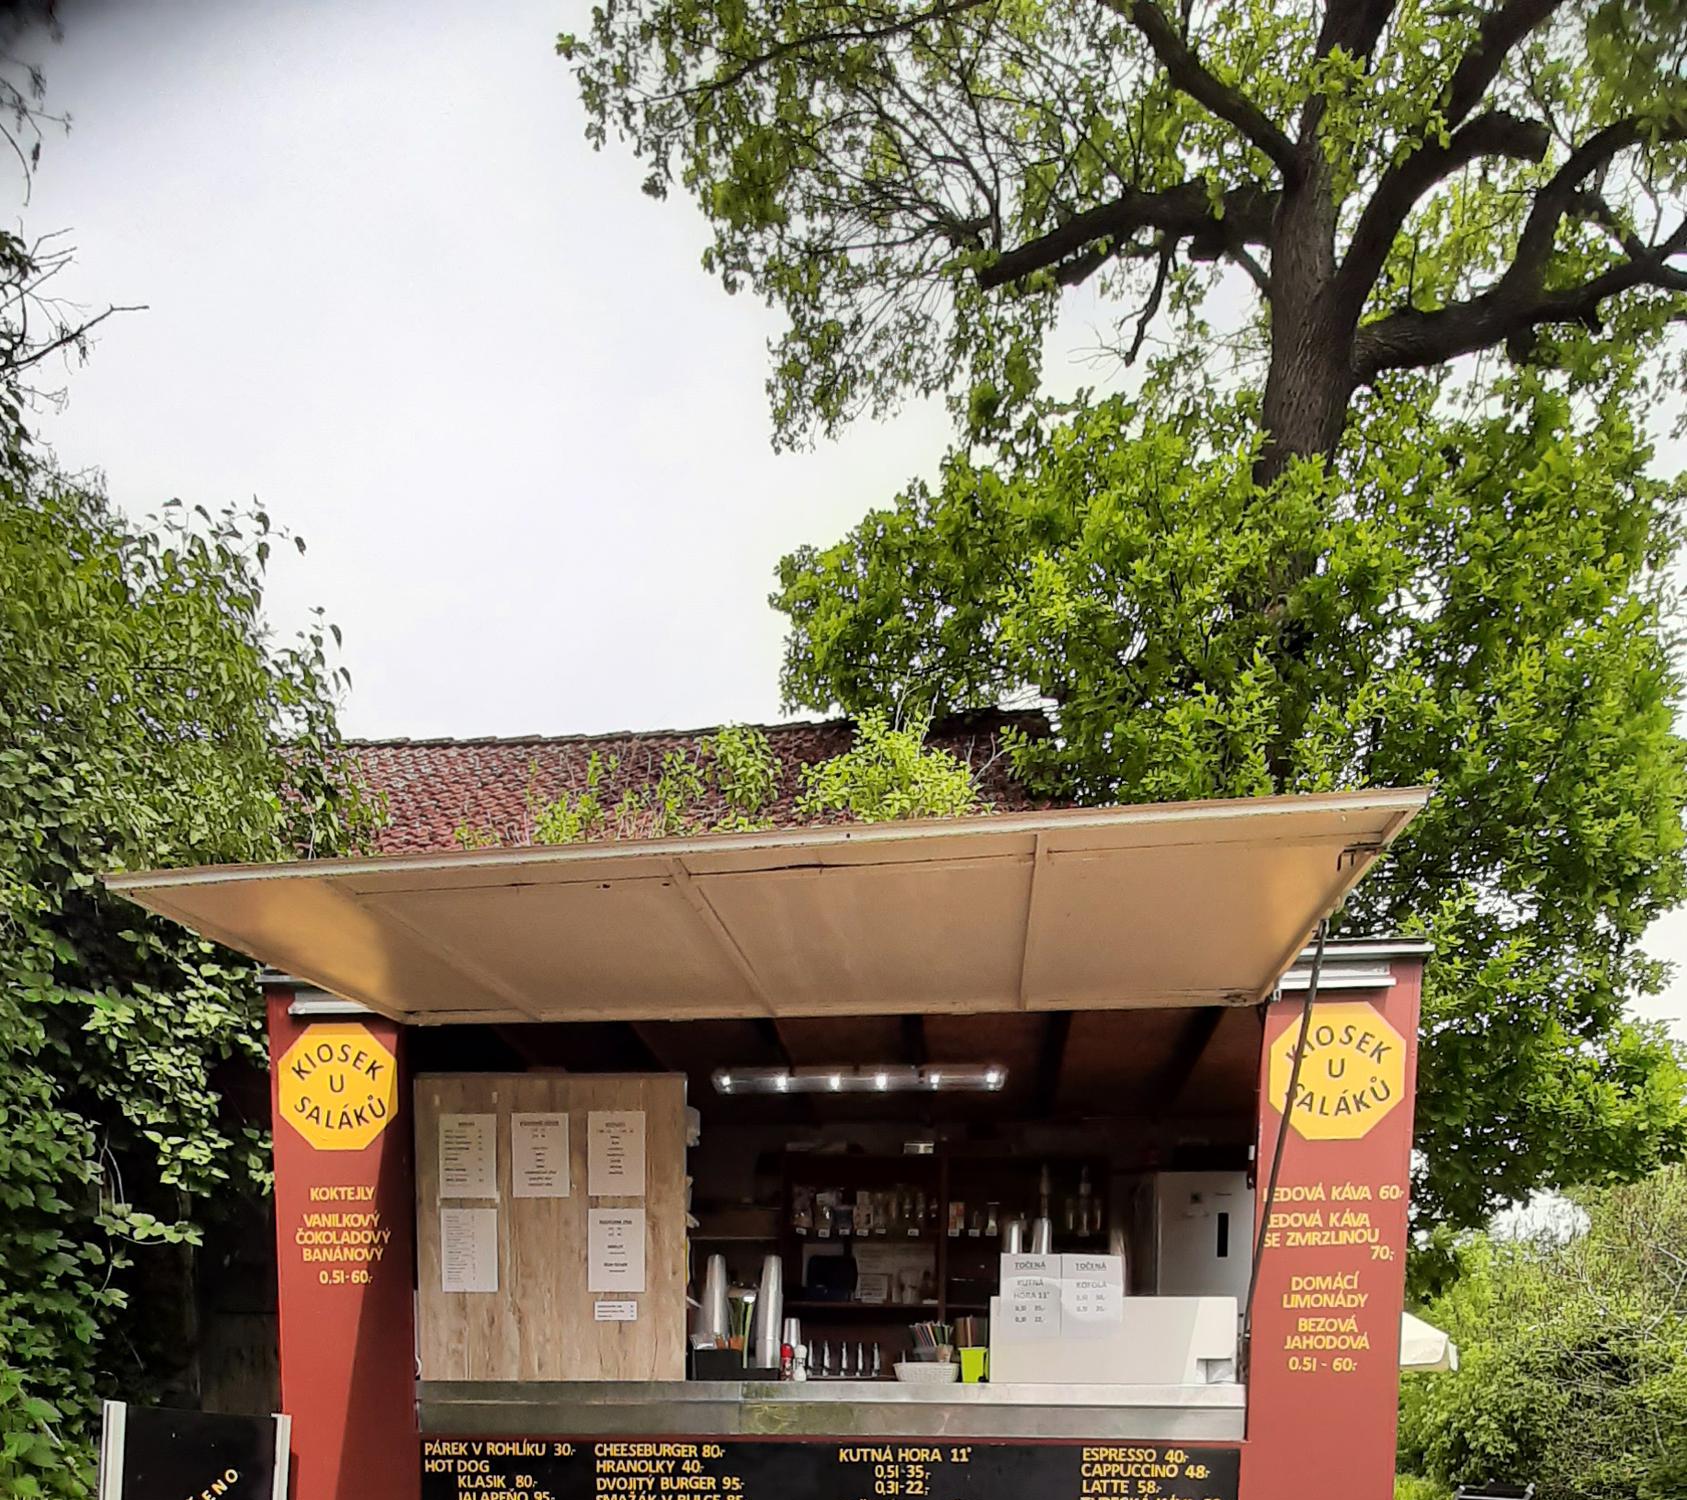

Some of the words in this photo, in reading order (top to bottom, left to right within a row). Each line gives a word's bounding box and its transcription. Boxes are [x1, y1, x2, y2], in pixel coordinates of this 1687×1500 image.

[292, 1044, 384, 1081] KIOSEK
[1329, 1058, 1345, 1078] U
[330, 1074, 344, 1092] U
[295, 1095, 385, 1129] SALÁKŮ
[310, 1186, 374, 1201] KOKTEJLY
[1331, 1182, 1372, 1201] KÁVA
[303, 1210, 380, 1227] VANILKOVÝ
[1268, 1209, 1323, 1228] EDOVÁ
[1329, 1208, 1370, 1227] KÁVA
[296, 1228, 391, 1244] ČOKOLADOVÝ
[1264, 1232, 1280, 1247] SE
[1286, 1228, 1379, 1246] ZMRZLINOU
[303, 1245, 383, 1261] BANÁNOVÝ
[1016, 1261, 1046, 1270] TOČENÁ
[1076, 1262, 1107, 1271] TOČENÁ
[1291, 1271, 1359, 1291] DOMÁCÍ
[1283, 1291, 1368, 1308] LIMONÁDY
[1298, 1315, 1358, 1332] BEZOVÁ
[1284, 1332, 1369, 1349] JAHODOVÁ
[425, 1440, 468, 1455] PÁREK
[471, 1443, 482, 1455] V
[487, 1438, 546, 1455] ROHLÍKU
[595, 1443, 698, 1457] CHEESEBURGER
[839, 1445, 893, 1462] KUTNÁ
[898, 1448, 942, 1462] HORA
[951, 1447, 972, 1462] 11°
[1083, 1448, 1156, 1462] ESPRESSO
[425, 1460, 453, 1472] HOT
[457, 1460, 490, 1472] DOG
[596, 1460, 675, 1473] HRANOLKY
[1081, 1464, 1178, 1477] CAPPUCCINO
[458, 1476, 506, 1488] KLASIK
[596, 1475, 655, 1490] DVOJITÝ
[661, 1477, 716, 1490] BURGER
[1082, 1480, 1129, 1493] LATTE
